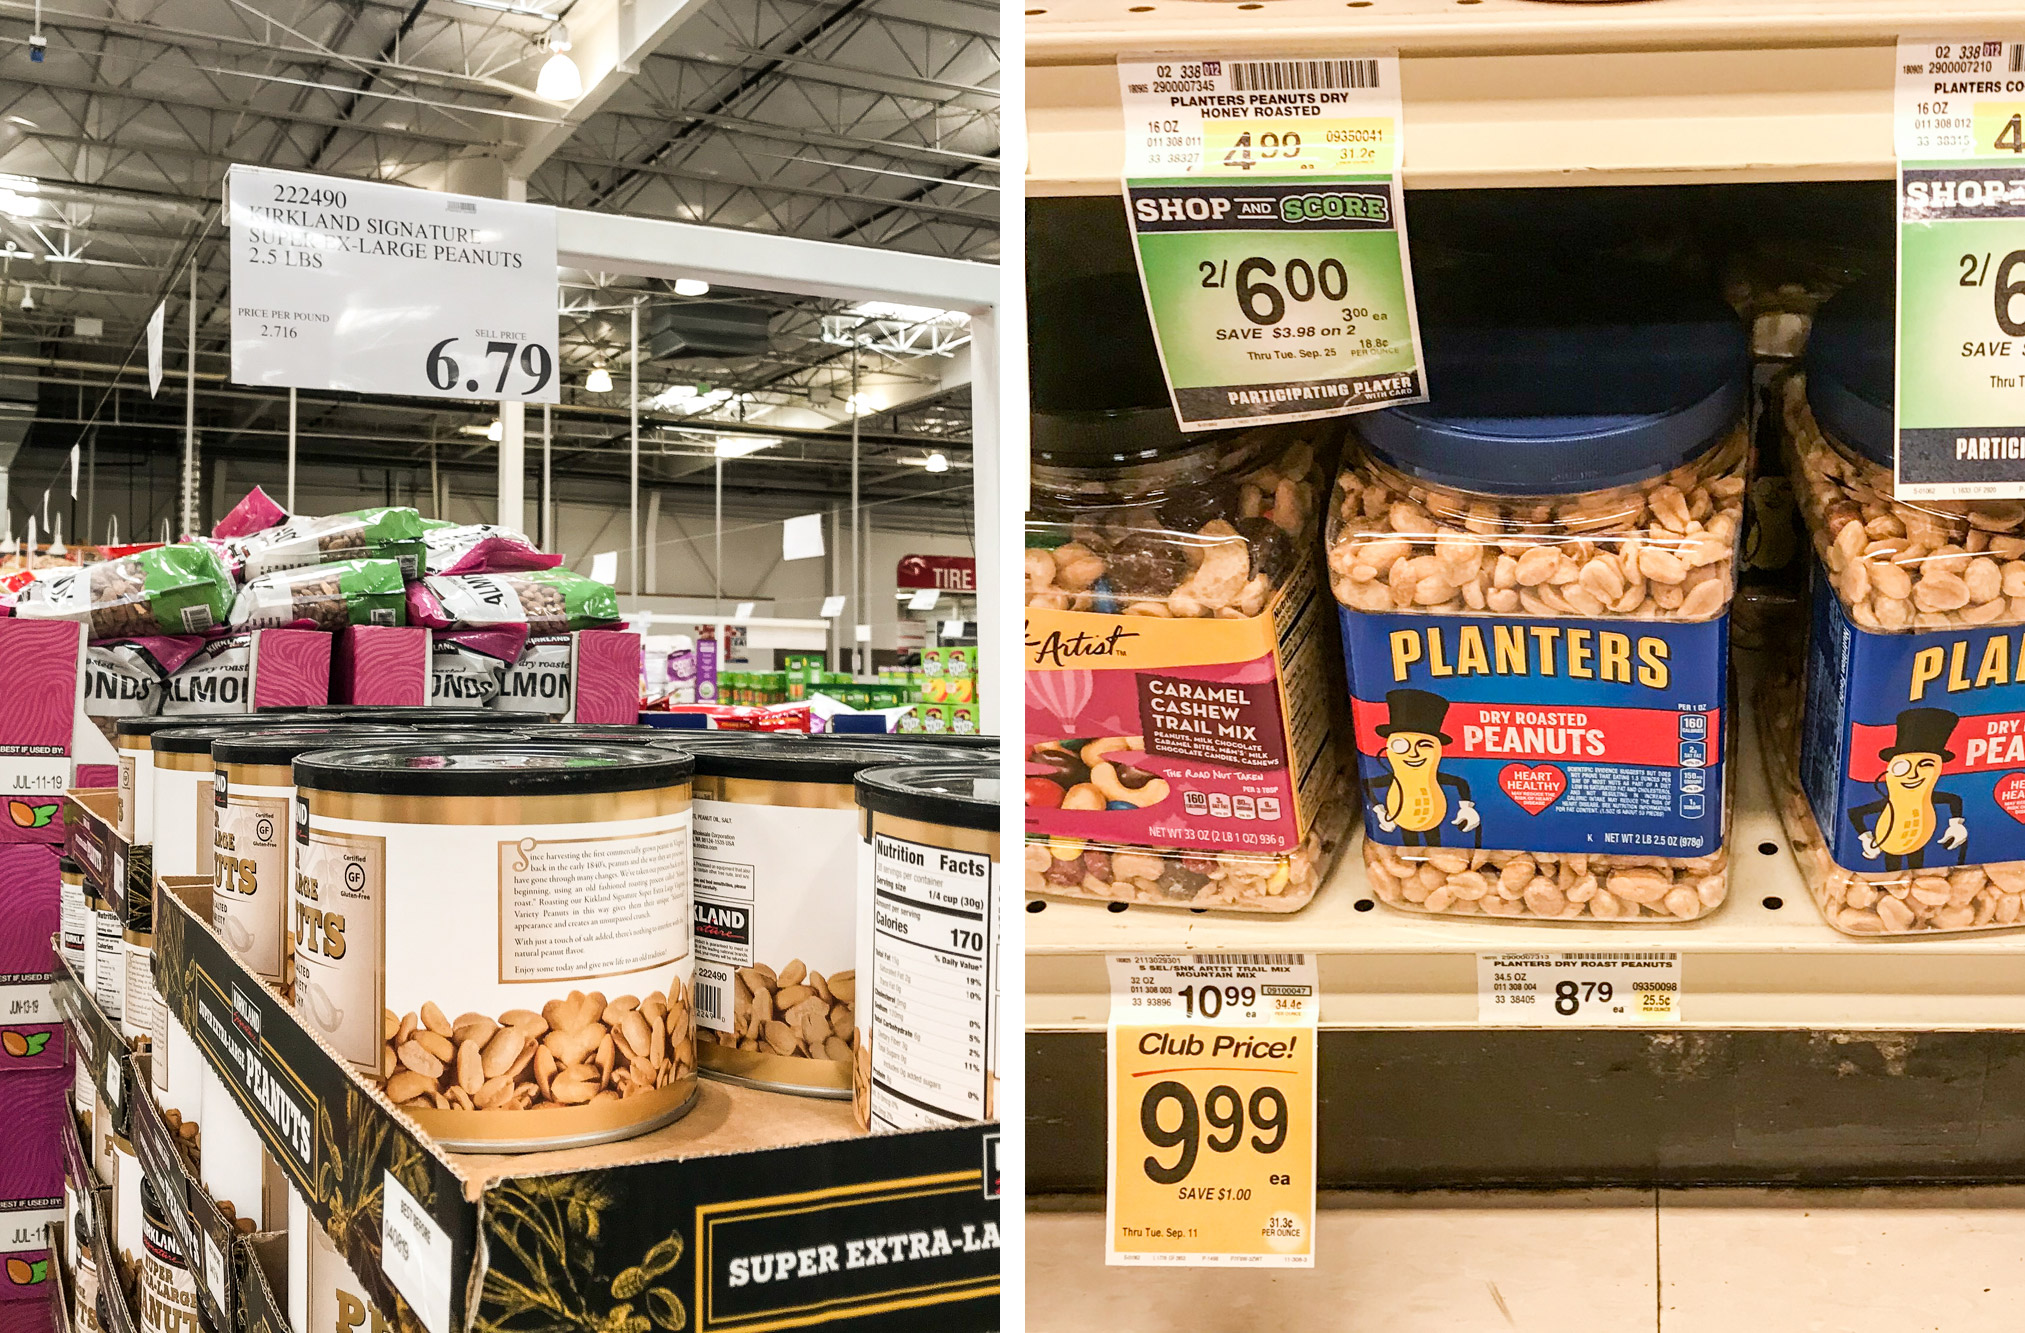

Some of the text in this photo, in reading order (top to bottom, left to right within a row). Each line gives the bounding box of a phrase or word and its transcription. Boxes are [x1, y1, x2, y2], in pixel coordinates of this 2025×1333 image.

[1936, 46, 1980, 59] 02 338
[1157, 65, 1172, 78] 02
[1929, 61, 1992, 73] 2900007210
[1153, 80, 1214, 92] 2900007345
[1934, 81, 2001, 94] PLANTERS
[1171, 93, 1349, 106] PLANTERS PEANUTS DRY
[1201, 106, 1320, 118] HONEY ROASTED
[1918, 102, 1948, 114] 16 OZ
[1148, 121, 1178, 133] 16 OZ
[1326, 129, 1383, 142] 09350041
[273, 185, 347, 208] 222490
[1907, 180, 2006, 208] SHOP
[1135, 193, 1387, 222] SHOP AND SCORE
[250, 205, 482, 245] KIRKLAND SIGNATURE
[249, 228, 522, 268] SUPER EX-LARGE PEANUTS
[249, 247, 323, 268] 2.5 LBS
[238, 307, 330, 322] PRICE PER POUND
[261, 324, 298, 339] 2.716
[475, 328, 527, 340] SELL PRICE
[1216, 325, 1356, 341] SAVE $3.98 on 2
[1248, 348, 1336, 361] Thru Tue. Sep. 25
[1961, 342, 2012, 357] SAVE
[426, 337, 552, 396] 6.79
[1990, 375, 2015, 388] Thru
[1227, 376, 1412, 406] PARTICIPATING PLAYER
[1364, 387, 1412, 400] WITH CARD
[933, 567, 972, 590] TIRE
[1035, 625, 1140, 667] Artist
[1388, 625, 1670, 690] PLANTERS
[1149, 680, 1250, 705] CARAMEL
[1150, 698, 1240, 721] CASHEW
[1479, 710, 1587, 727] DRY ROASTED
[1684, 718, 1702, 729] 160
[1152, 714, 1256, 741] TRAIL MIX
[1987, 721, 2017, 735] DRY
[1155, 738, 1192, 749] CARAMEL
[1194, 736, 1262, 752] MILK CHOCOLATE
[1463, 725, 1606, 756] PEANUTS
[0, 746, 50, 754] BEST USED
[1156, 744, 1279, 766] CHOCOLATE CASHEWS
[1163, 769, 1264, 781] THE ROAD NUT TAKEN
[1514, 770, 1552, 781] HEART
[13, 775, 63, 790] JUL-11-19
[1507, 779, 1560, 792] HEALTHY
[1186, 794, 1204, 804] 160
[259, 826, 270, 834] GF
[1150, 827, 1275, 844] NET WT 33 OZ OZ) 936
[1604, 833, 1703, 849] NET WT 2.5 (978g)
[343, 854, 366, 863] Certified
[546, 852, 580, 860] harvesting
[878, 840, 985, 877] Nutrition Facts
[531, 864, 546, 872] back
[348, 872, 361, 882] GF
[514, 875, 576, 884] have through
[340, 890, 371, 900] Gluten-Free
[929, 890, 984, 910] 1/4 cup (30g)
[539, 898, 568, 906] Roasting
[876, 910, 908, 934] Calories
[951, 928, 983, 951] 170
[699, 968, 727, 981] 222490
[1494, 973, 1526, 981] 34.5 OZ
[1632, 982, 1677, 991] 09350098
[1510, 996, 1535, 1004] 38405
[233, 988, 260, 1033] KIRKLAND
[1138, 1032, 1297, 1059] Club Price!
[212, 1016, 311, 1164] EXTRA-LARGE PEANUTS
[1270, 1173, 1290, 1185] ea
[1178, 1187, 1251, 1201] SAVE $1.00
[1122, 1227, 1198, 1239] Thru Tue. Sep. 11
[1262, 1228, 1300, 1237] PER OUNCE
[728, 1243, 840, 1288] SUPER
